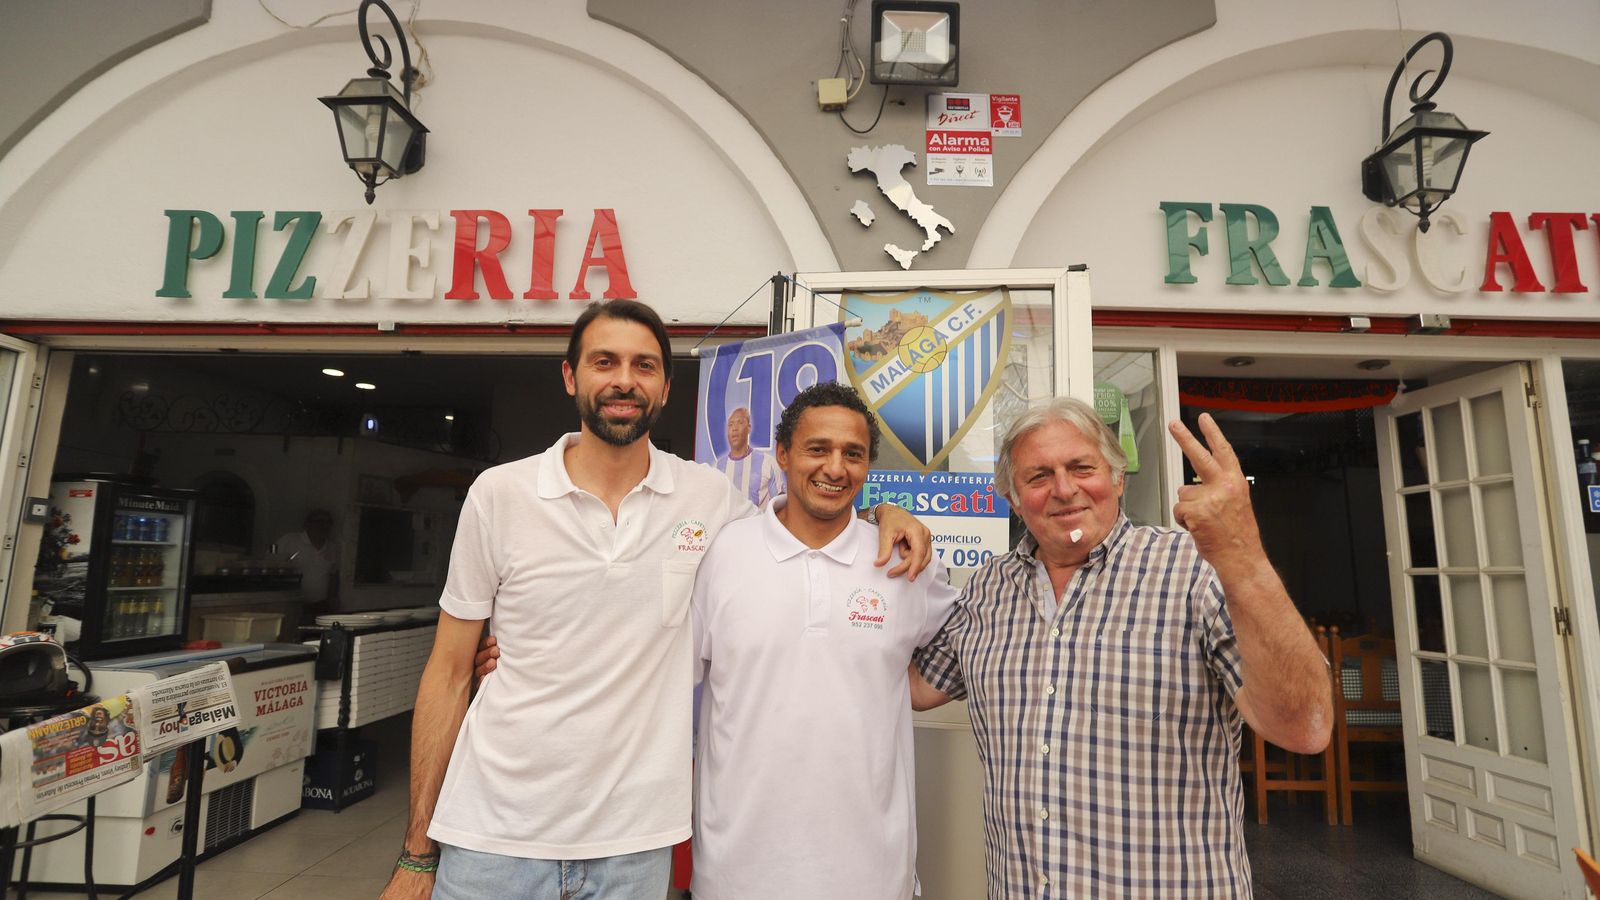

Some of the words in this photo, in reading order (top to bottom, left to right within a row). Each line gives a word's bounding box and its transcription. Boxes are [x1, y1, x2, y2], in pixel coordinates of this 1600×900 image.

[937, 109, 980, 126] Direct
[929, 133, 990, 146] Alarma
[155, 208, 638, 300] PIZZERIA
[1159, 201, 1600, 293] FRASCAT
[869, 328, 949, 394] MALAGA
[947, 303, 983, 332] C.F.
[867, 474, 913, 483] IZZERIA
[931, 475, 995, 485] CAFETERIA
[118, 497, 154, 510] Minute
[154, 500, 180, 511] Maid
[859, 482, 996, 514] Frascati
[930, 534, 982, 544] DOMICILIO
[848, 610, 885, 623] Frascati
[254, 680, 308, 702] VICTORIA
[188, 704, 237, 728] Málaga
[26, 715, 87, 741] GRIEZMANN
[159, 719, 180, 736] hoy
[96, 731, 136, 765] as
